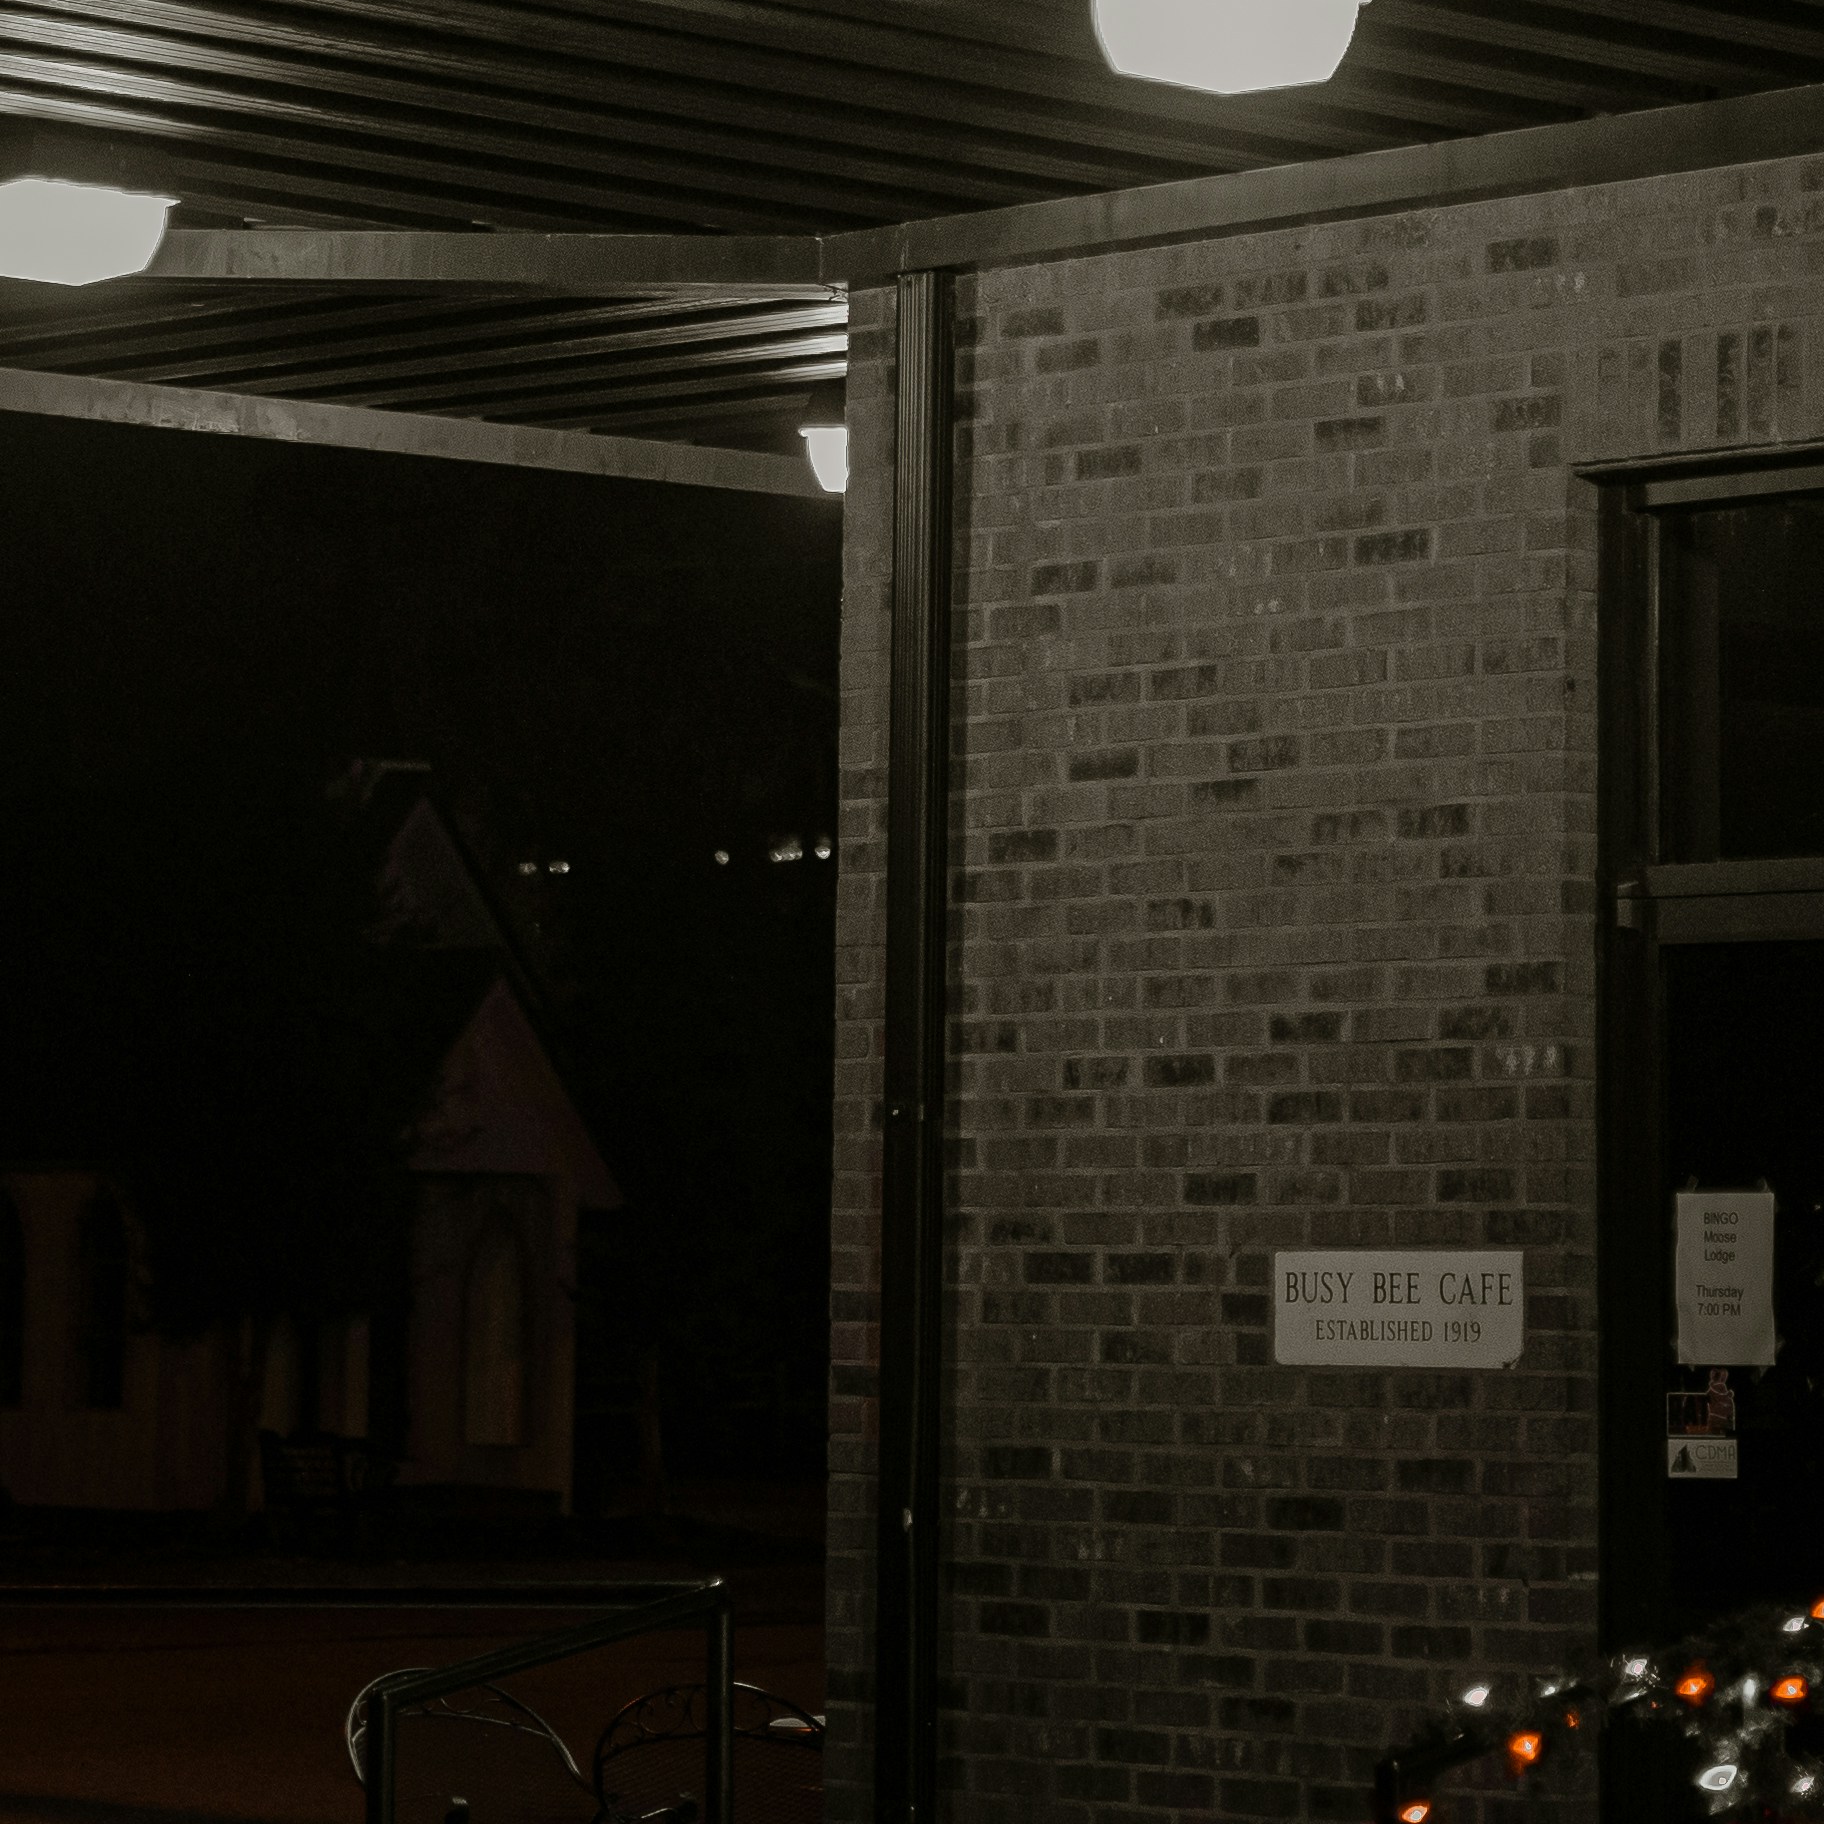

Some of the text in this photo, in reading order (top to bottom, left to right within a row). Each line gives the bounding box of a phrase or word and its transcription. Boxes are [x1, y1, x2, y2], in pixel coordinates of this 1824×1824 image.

[1703, 1211, 1740, 1225] BINGO
[1703, 1230, 1738, 1244] Moose
[1704, 1248, 1736, 1265] Lodge
[1285, 1271, 1513, 1305] BUSY BEE CAFE
[1696, 1284, 1745, 1302] Thursday
[1698, 1303, 1741, 1316] 7:00 PM
[1315, 1320, 1482, 1343] ESTABLISHED 1919
[1695, 1444, 1736, 1461] CDMA
